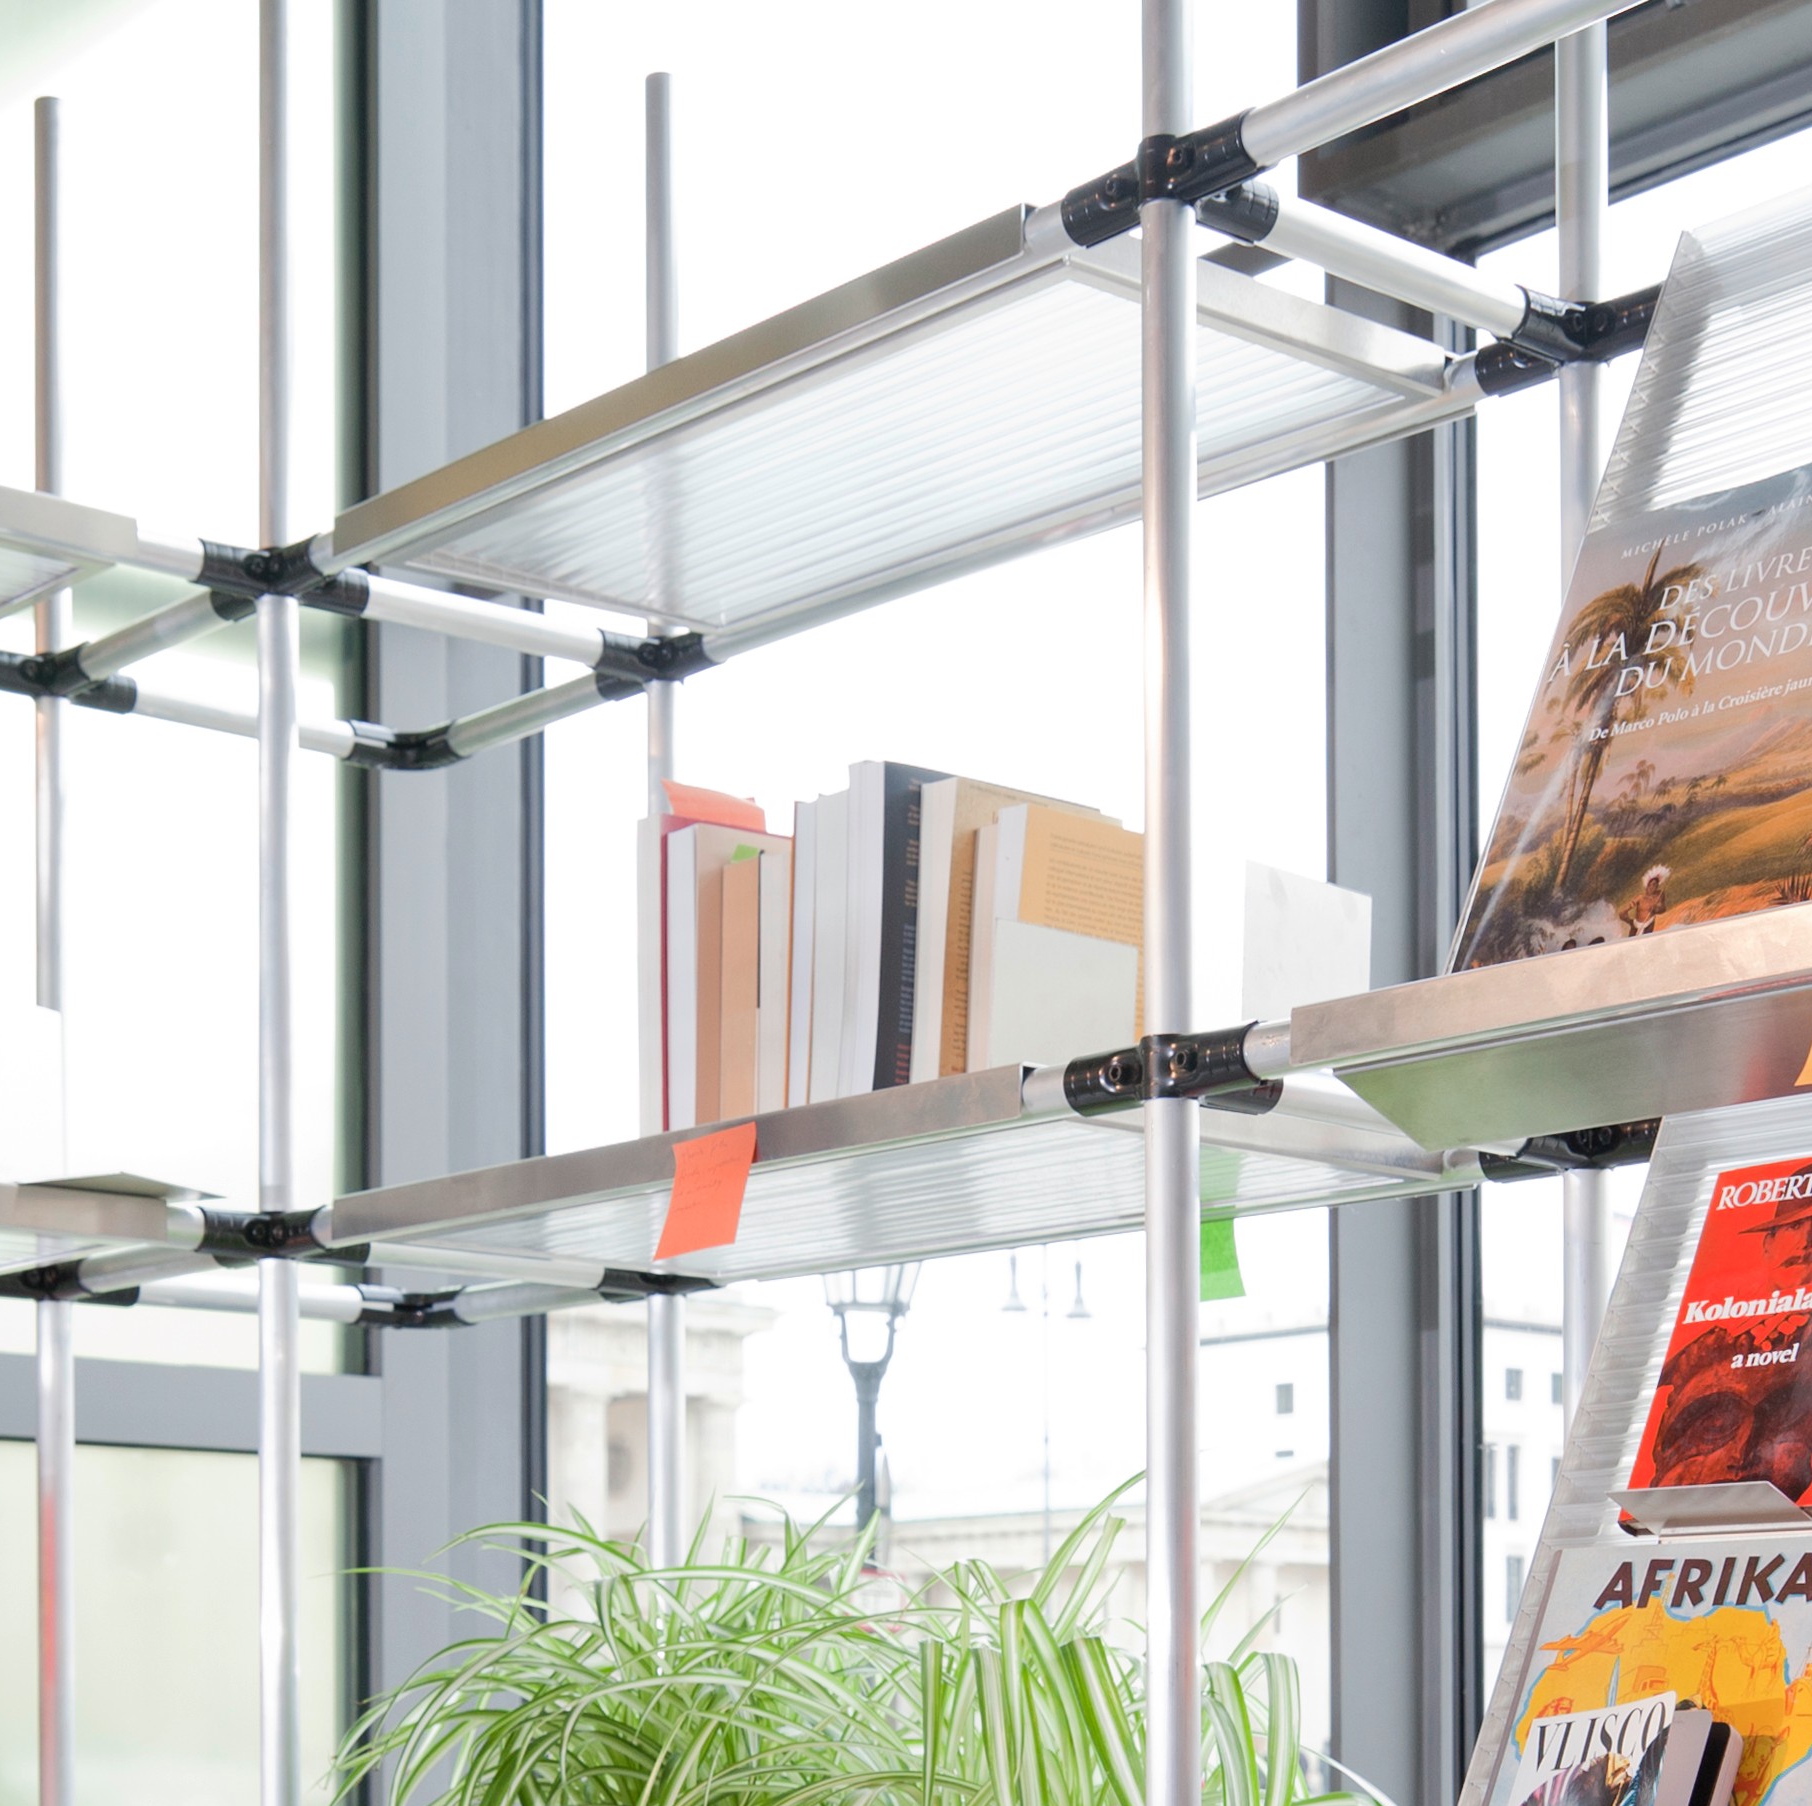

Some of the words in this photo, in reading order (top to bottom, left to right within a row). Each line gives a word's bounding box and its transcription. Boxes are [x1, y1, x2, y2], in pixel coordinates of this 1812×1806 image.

[1696, 513, 1748, 537] POLAK
[1658, 574, 1719, 611] DES
[1584, 633, 1630, 671] LA
[1614, 662, 1668, 698] DU
[1588, 726, 1609, 743] De
[1609, 714, 1656, 739] Marco
[1658, 707, 1689, 727] Polo
[1691, 703, 1700, 718] à
[1702, 700, 1716, 715] la
[1718, 683, 1783, 712] Croisière
[1730, 1353, 1744, 1369] a
[1745, 1343, 1800, 1367] novel
[1536, 1701, 1668, 1773] VLISCO
